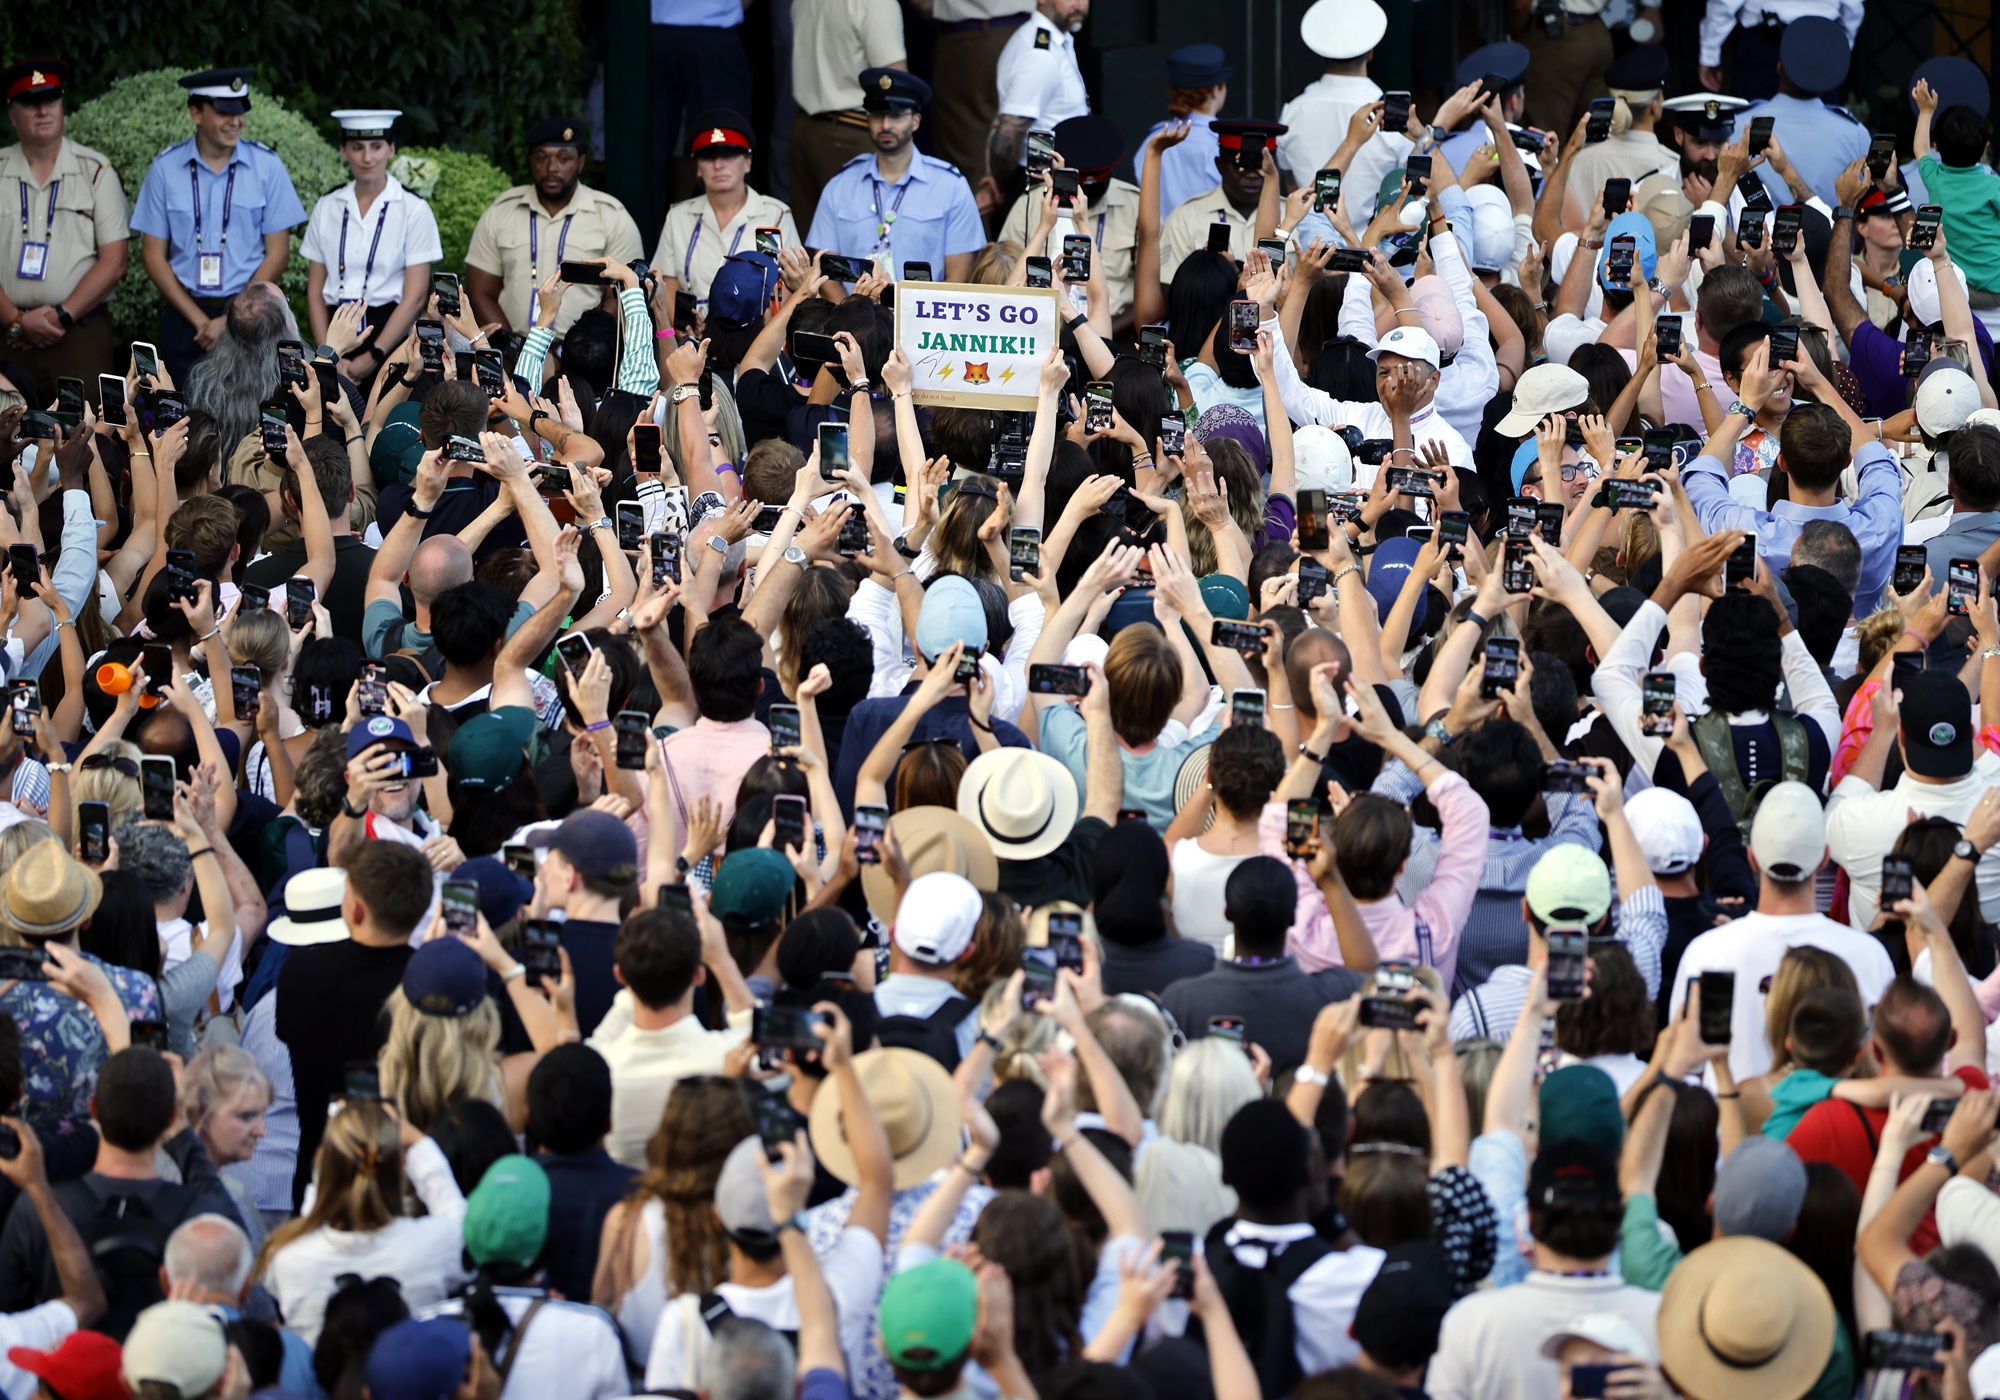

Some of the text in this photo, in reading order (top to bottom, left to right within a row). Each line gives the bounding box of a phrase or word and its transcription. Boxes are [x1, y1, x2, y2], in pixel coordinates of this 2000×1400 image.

[916, 300, 1039, 325] LET’S GO
[918, 331, 1036, 356] JANNIK!!
[921, 392, 929, 400] do
[940, 394, 956, 402] bend
